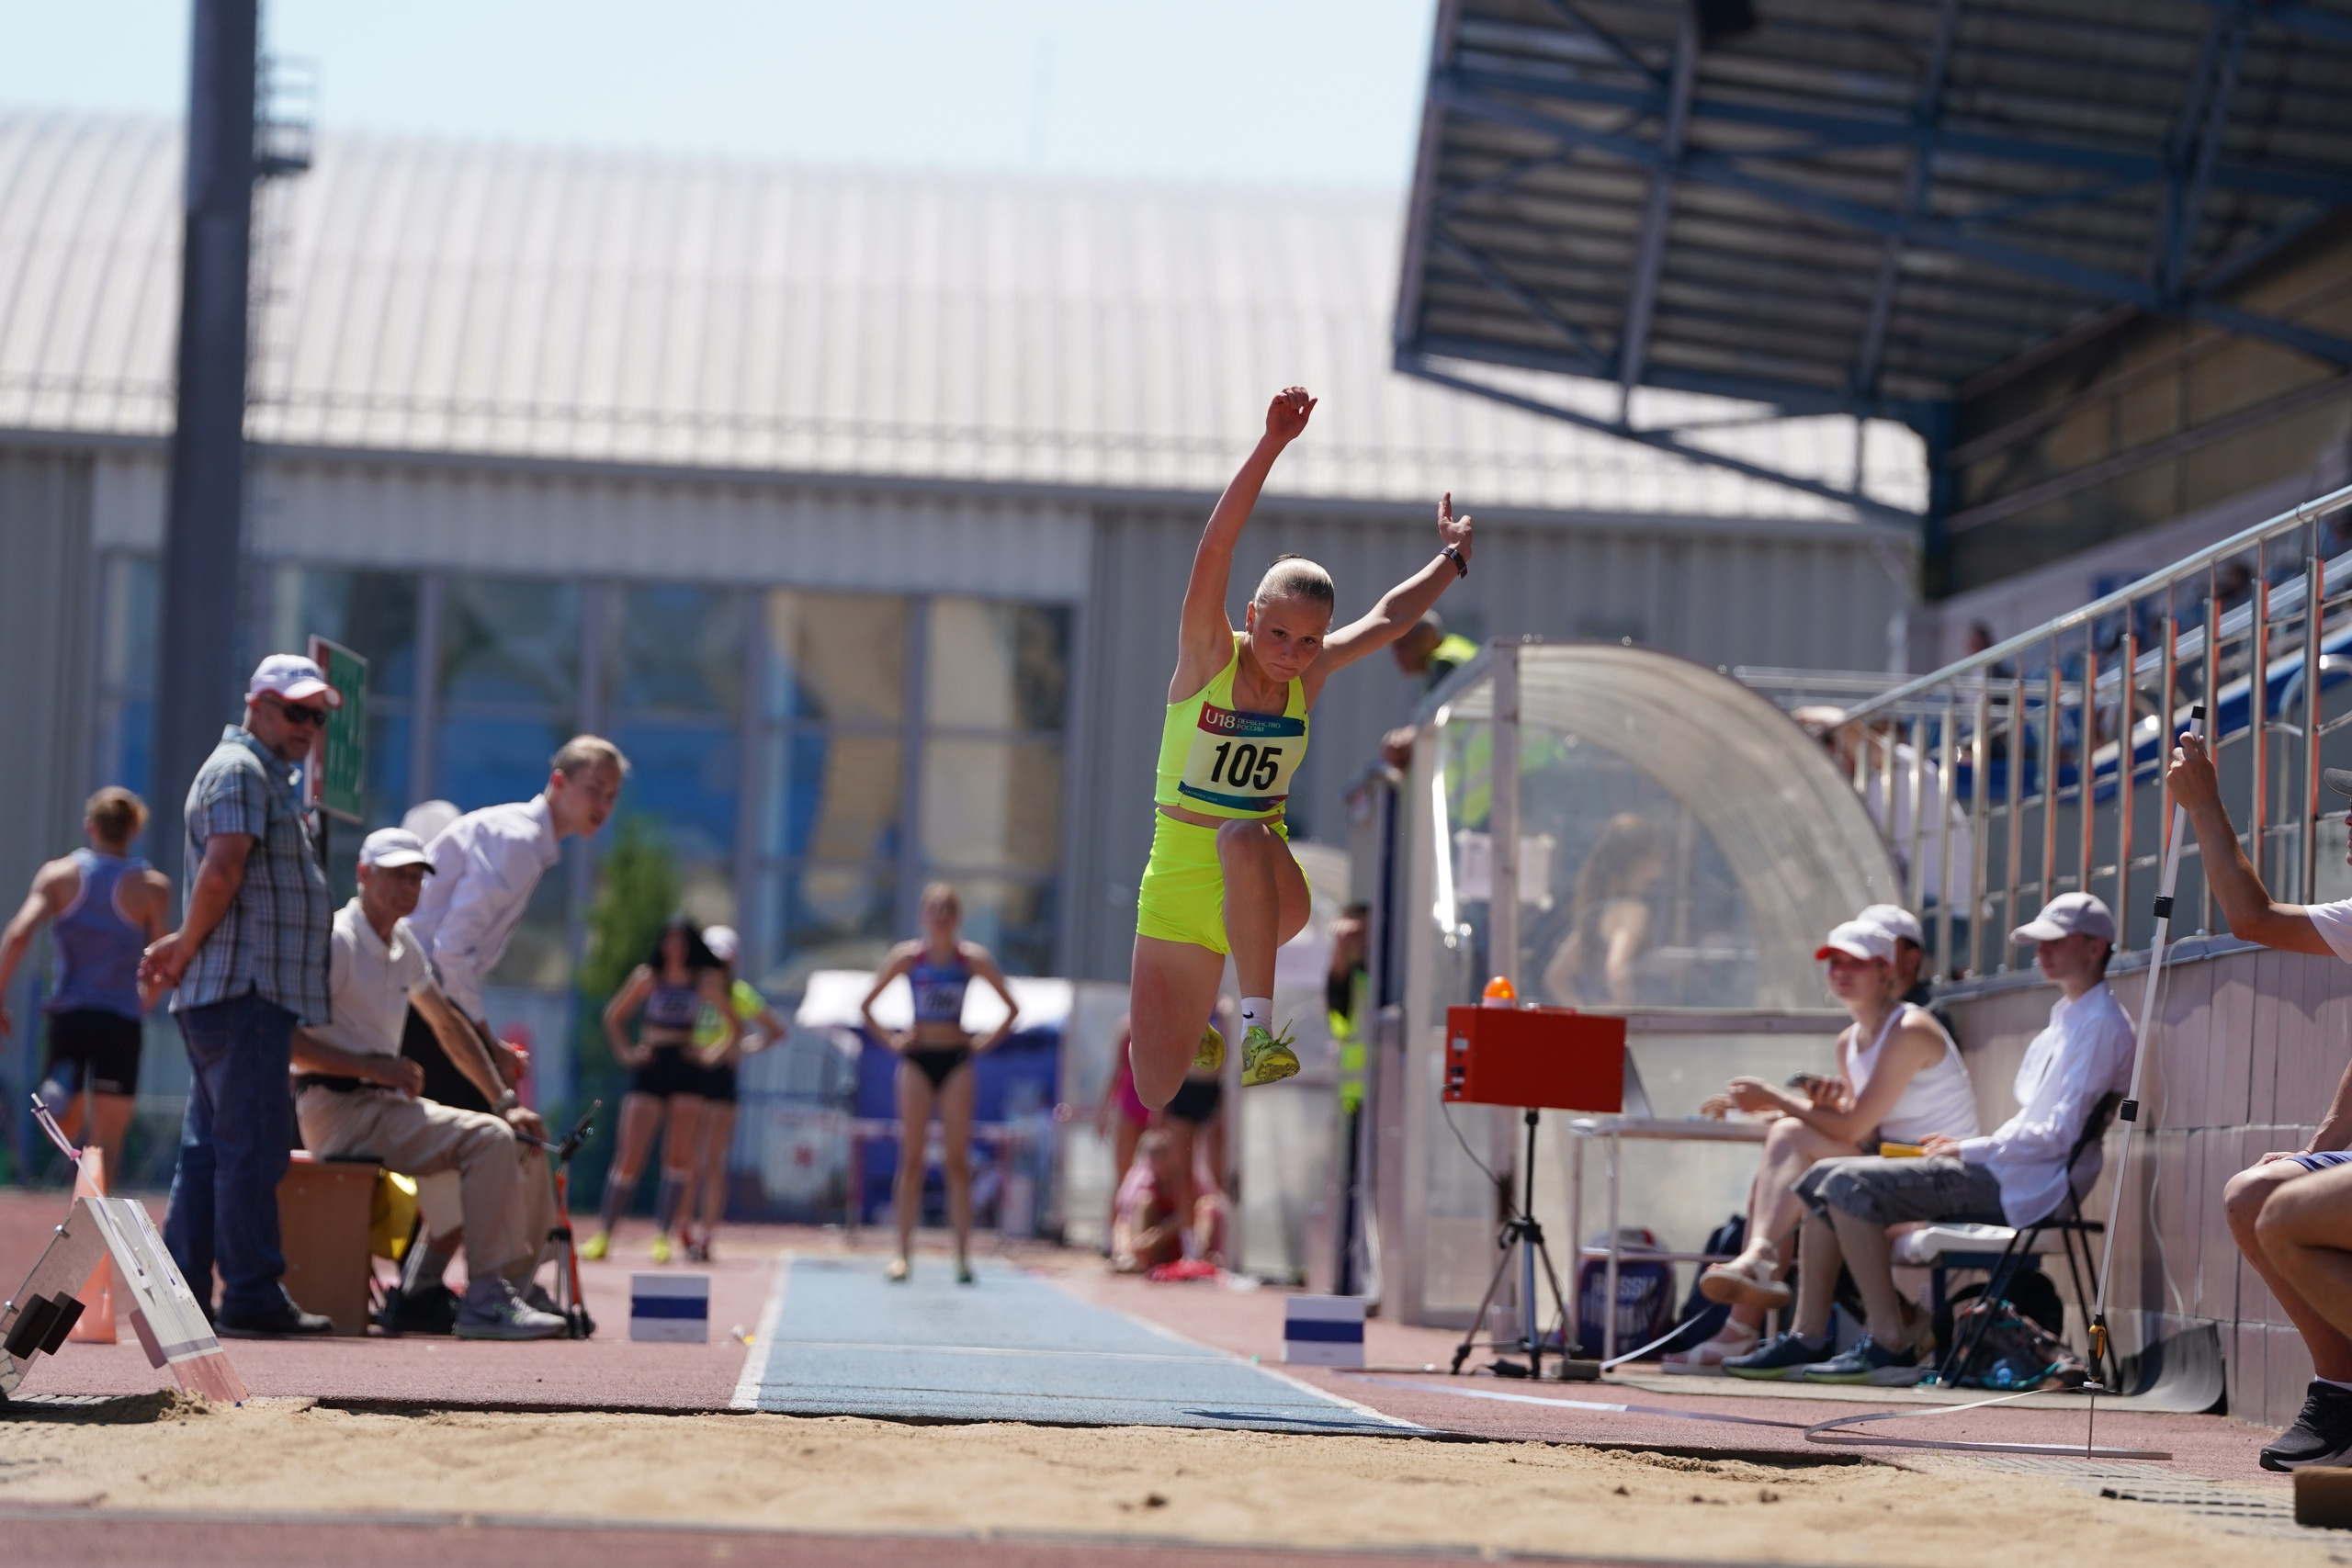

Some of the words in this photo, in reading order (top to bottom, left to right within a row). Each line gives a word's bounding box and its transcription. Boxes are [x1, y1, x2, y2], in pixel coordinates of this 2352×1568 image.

[1205, 709, 1236, 728] U18
[1237, 717, 1282, 729] ПЕРВЕНСТВО
[1236, 723, 1265, 733] РОССИИ
[1210, 741, 1283, 791] 105
